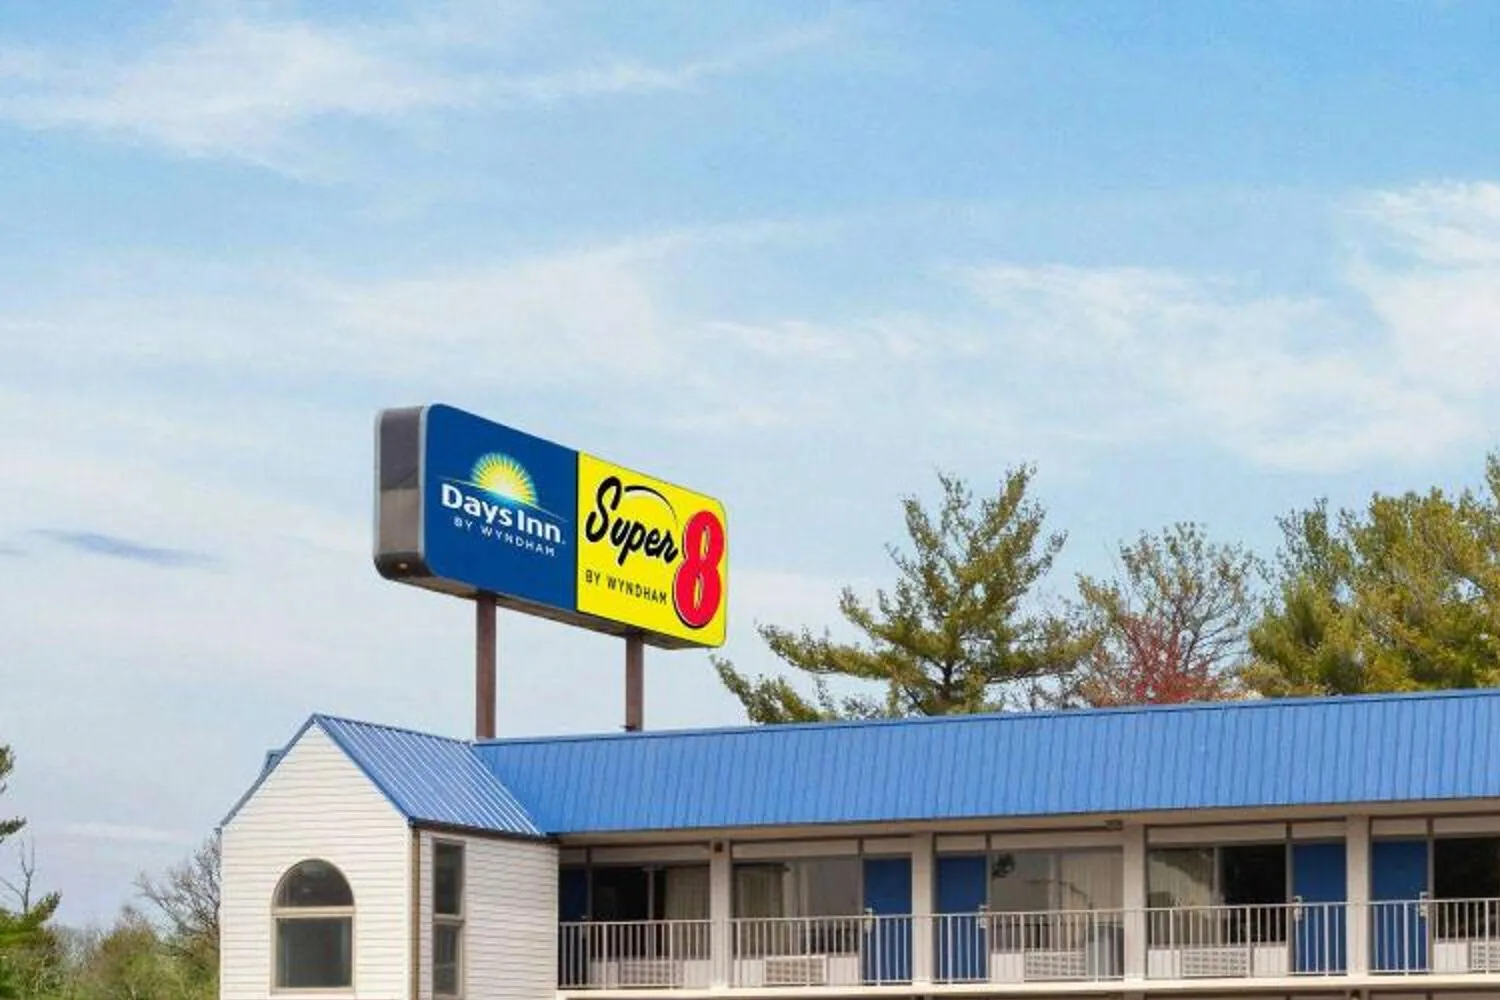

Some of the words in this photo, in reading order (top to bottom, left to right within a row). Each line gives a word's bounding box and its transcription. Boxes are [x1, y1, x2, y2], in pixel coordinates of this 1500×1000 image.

[441, 483, 513, 527] Days
[517, 509, 561, 543] Inn
[453, 516, 473, 530] BY
[481, 525, 555, 557] WYNDHAM
[585, 476, 679, 566] Super
[672, 510, 724, 629] 8
[585, 569, 600, 586] BY
[606, 576, 667, 605] WYNDHAM
